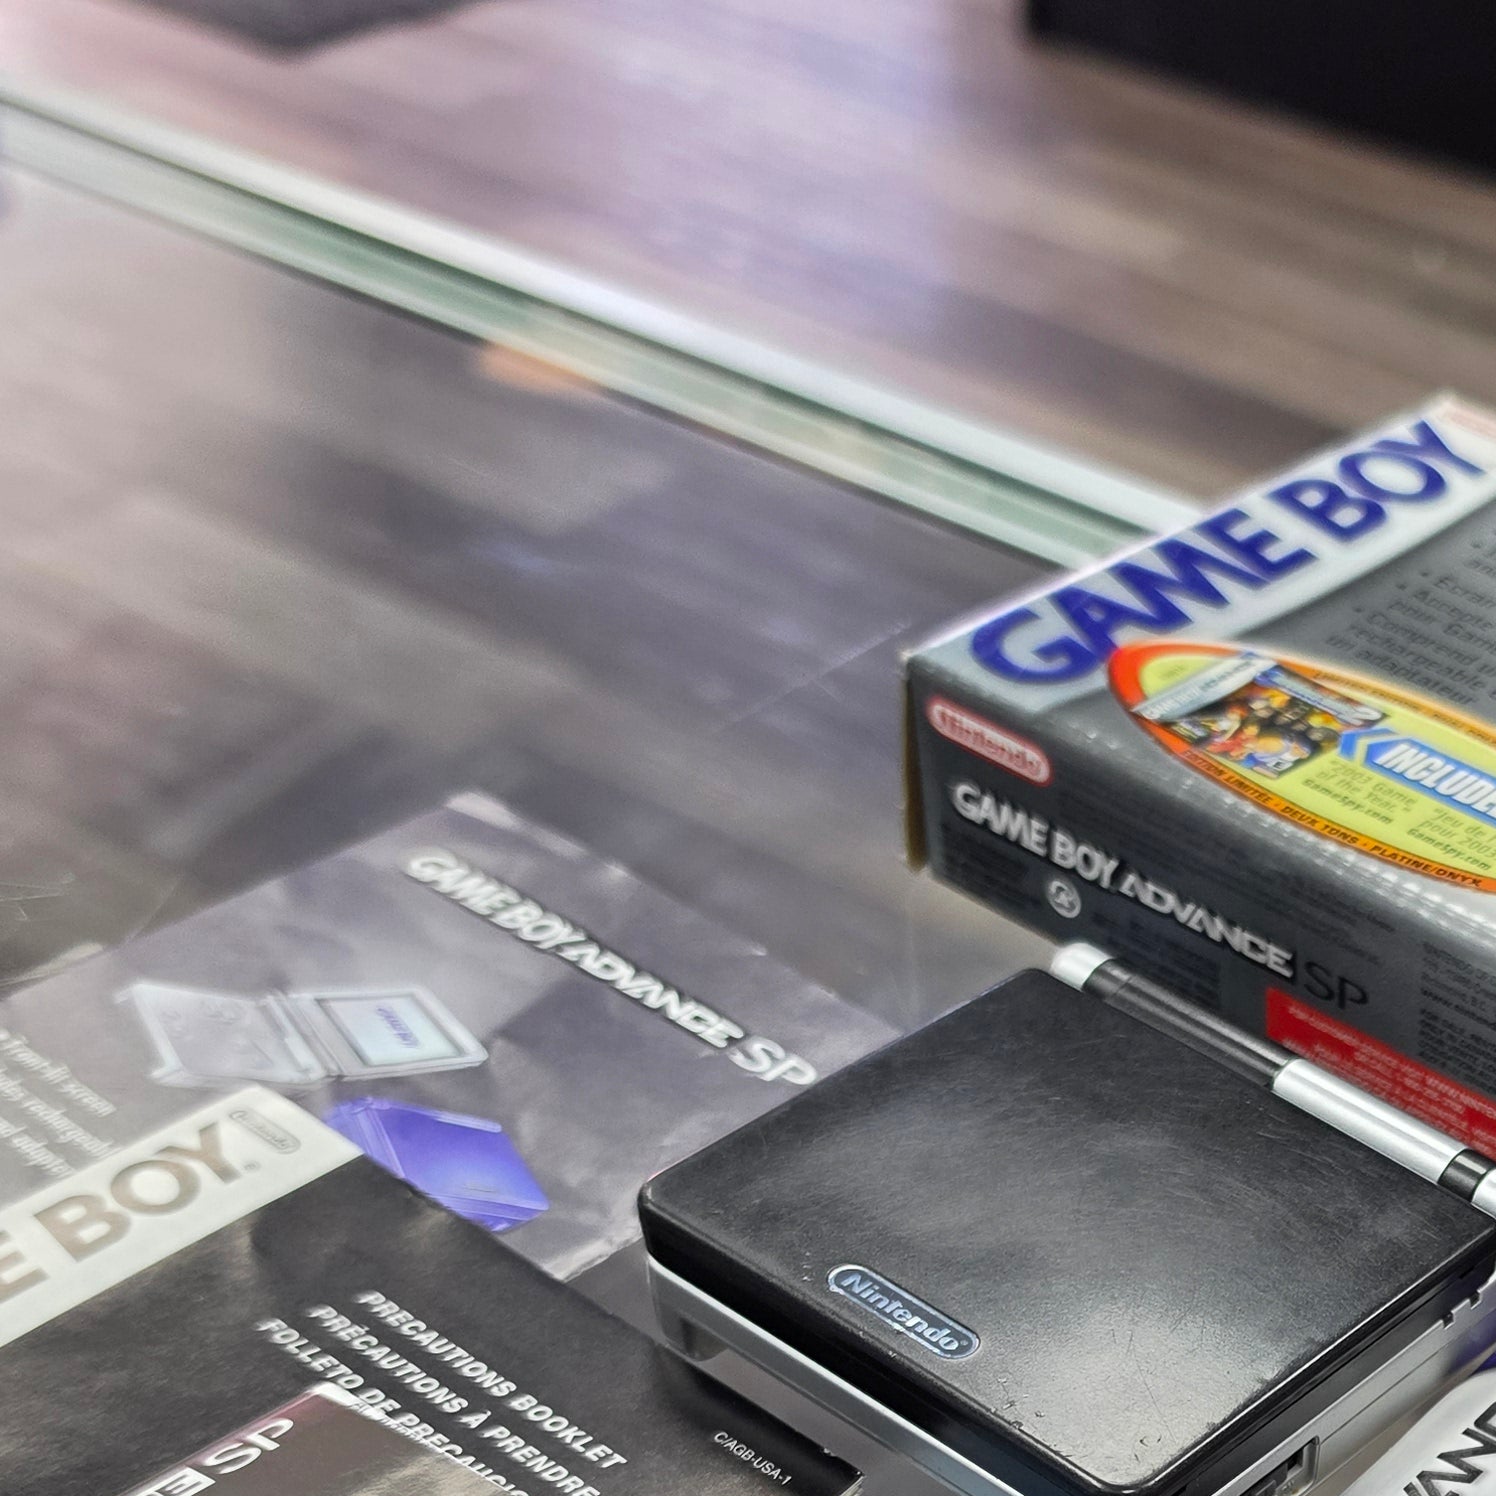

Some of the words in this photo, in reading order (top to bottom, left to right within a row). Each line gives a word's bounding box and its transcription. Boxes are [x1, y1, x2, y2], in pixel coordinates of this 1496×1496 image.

[971, 508, 1319, 684] GAME
[1270, 420, 1487, 546] BOY
[938, 704, 1044, 782] Nintendo
[1304, 778, 1394, 827] GameSpy.com
[1373, 780, 1419, 806] Game
[1281, 805, 1321, 827] DEUX
[1322, 823, 1359, 845] TONS
[1369, 843, 1482, 888] PLATINE/ONYX
[1407, 827, 1492, 871] GameSpy.com
[954, 782, 1050, 860] GAME
[1049, 826, 1117, 886] BOY
[1115, 873, 1295, 978] ADVANCE
[1302, 957, 1370, 1011] SP
[403, 848, 512, 917] GAME
[496, 898, 588, 952] BOY
[557, 940, 744, 1049] ADVANCE
[728, 1037, 817, 1086] SP
[34, 1121, 241, 1264] BOY
[841, 1272, 961, 1351] Nintendo
[255, 1318, 365, 1391] FOLLETO
[358, 1387, 402, 1416] DE
[307, 1304, 469, 1414] PRÉCAUTIONS
[456, 1408, 492, 1429] À
[353, 1290, 517, 1398] PRECAUTIONS
[506, 1394, 628, 1469] BOOKLET
[202, 1417, 295, 1475] SP
[713, 1431, 792, 1487] C/AGB-USA-1
